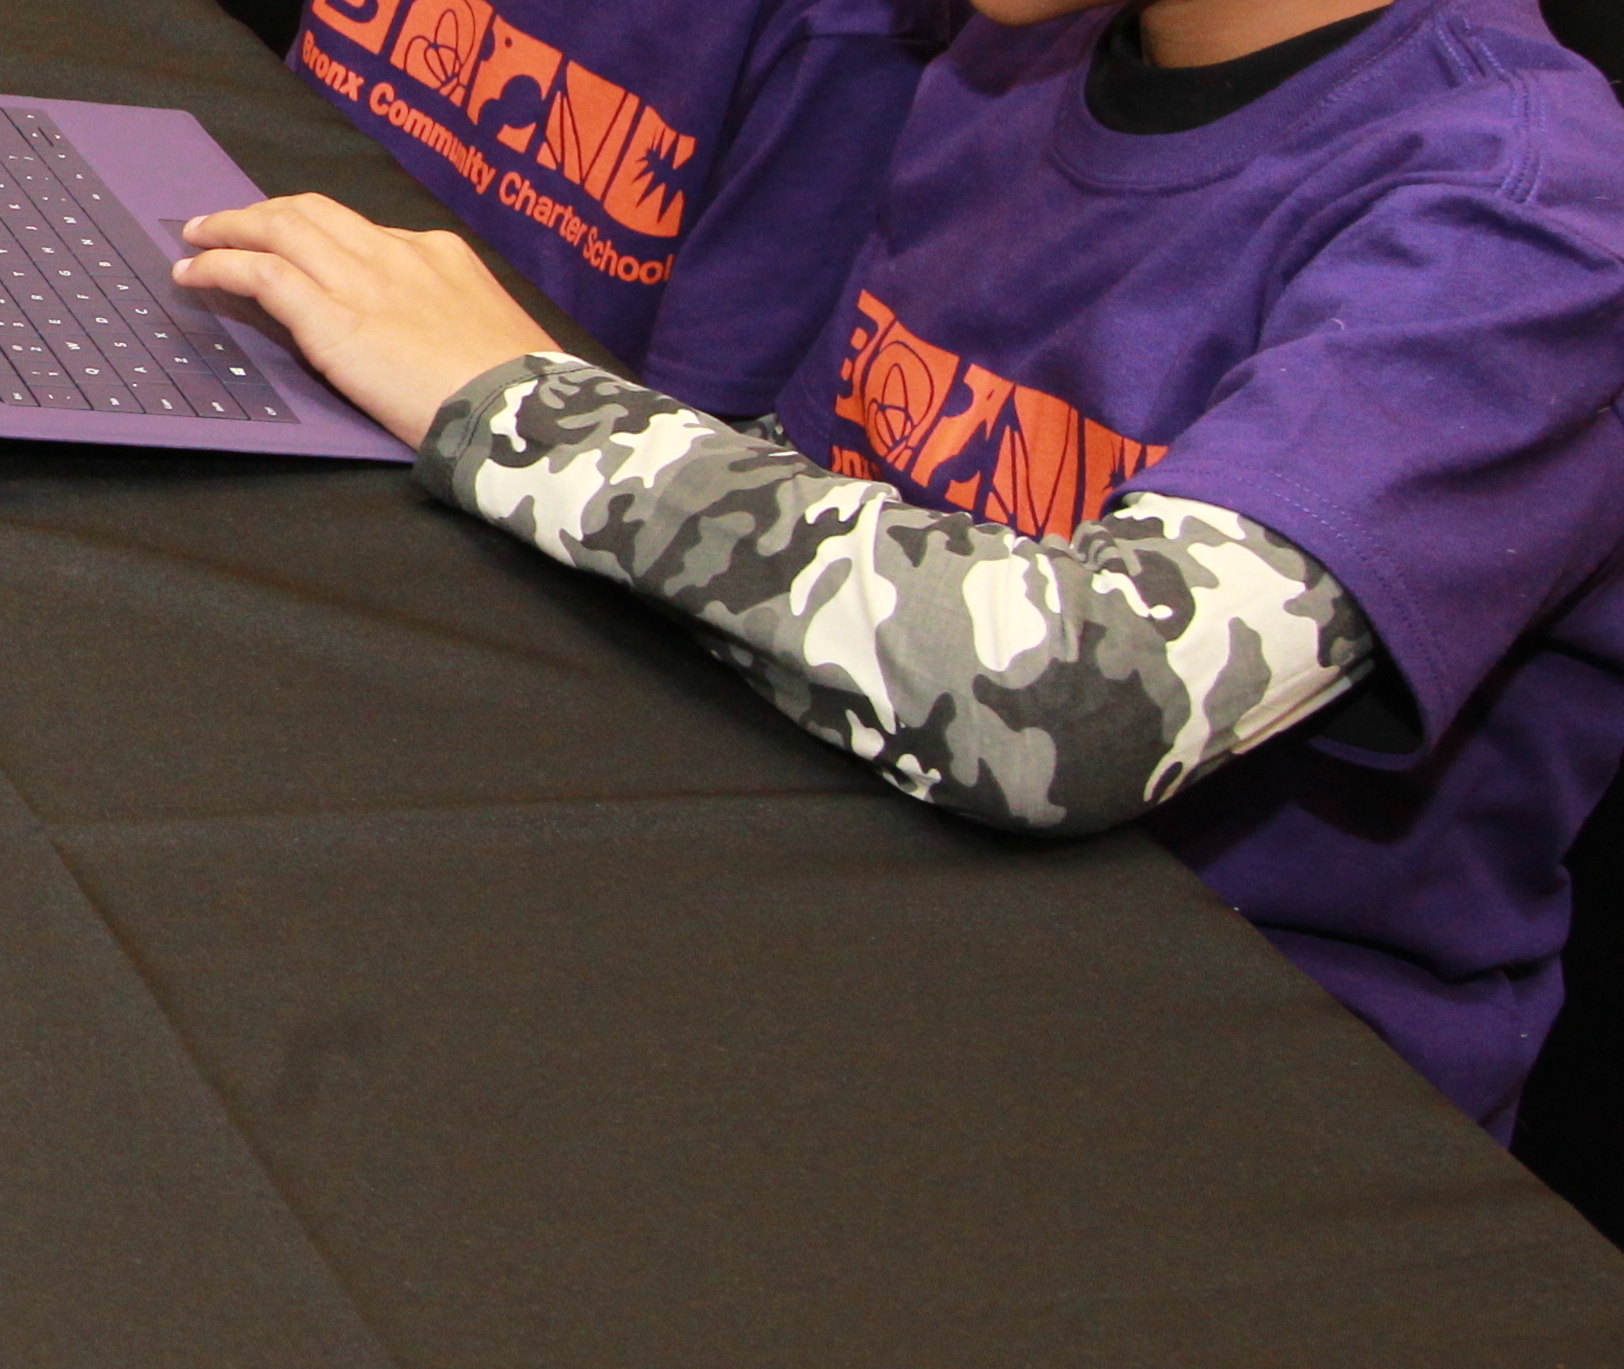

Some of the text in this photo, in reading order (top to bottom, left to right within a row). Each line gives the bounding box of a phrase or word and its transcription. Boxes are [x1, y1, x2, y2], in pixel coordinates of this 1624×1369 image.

[302, 29, 675, 286] Bronx Community Charter School
